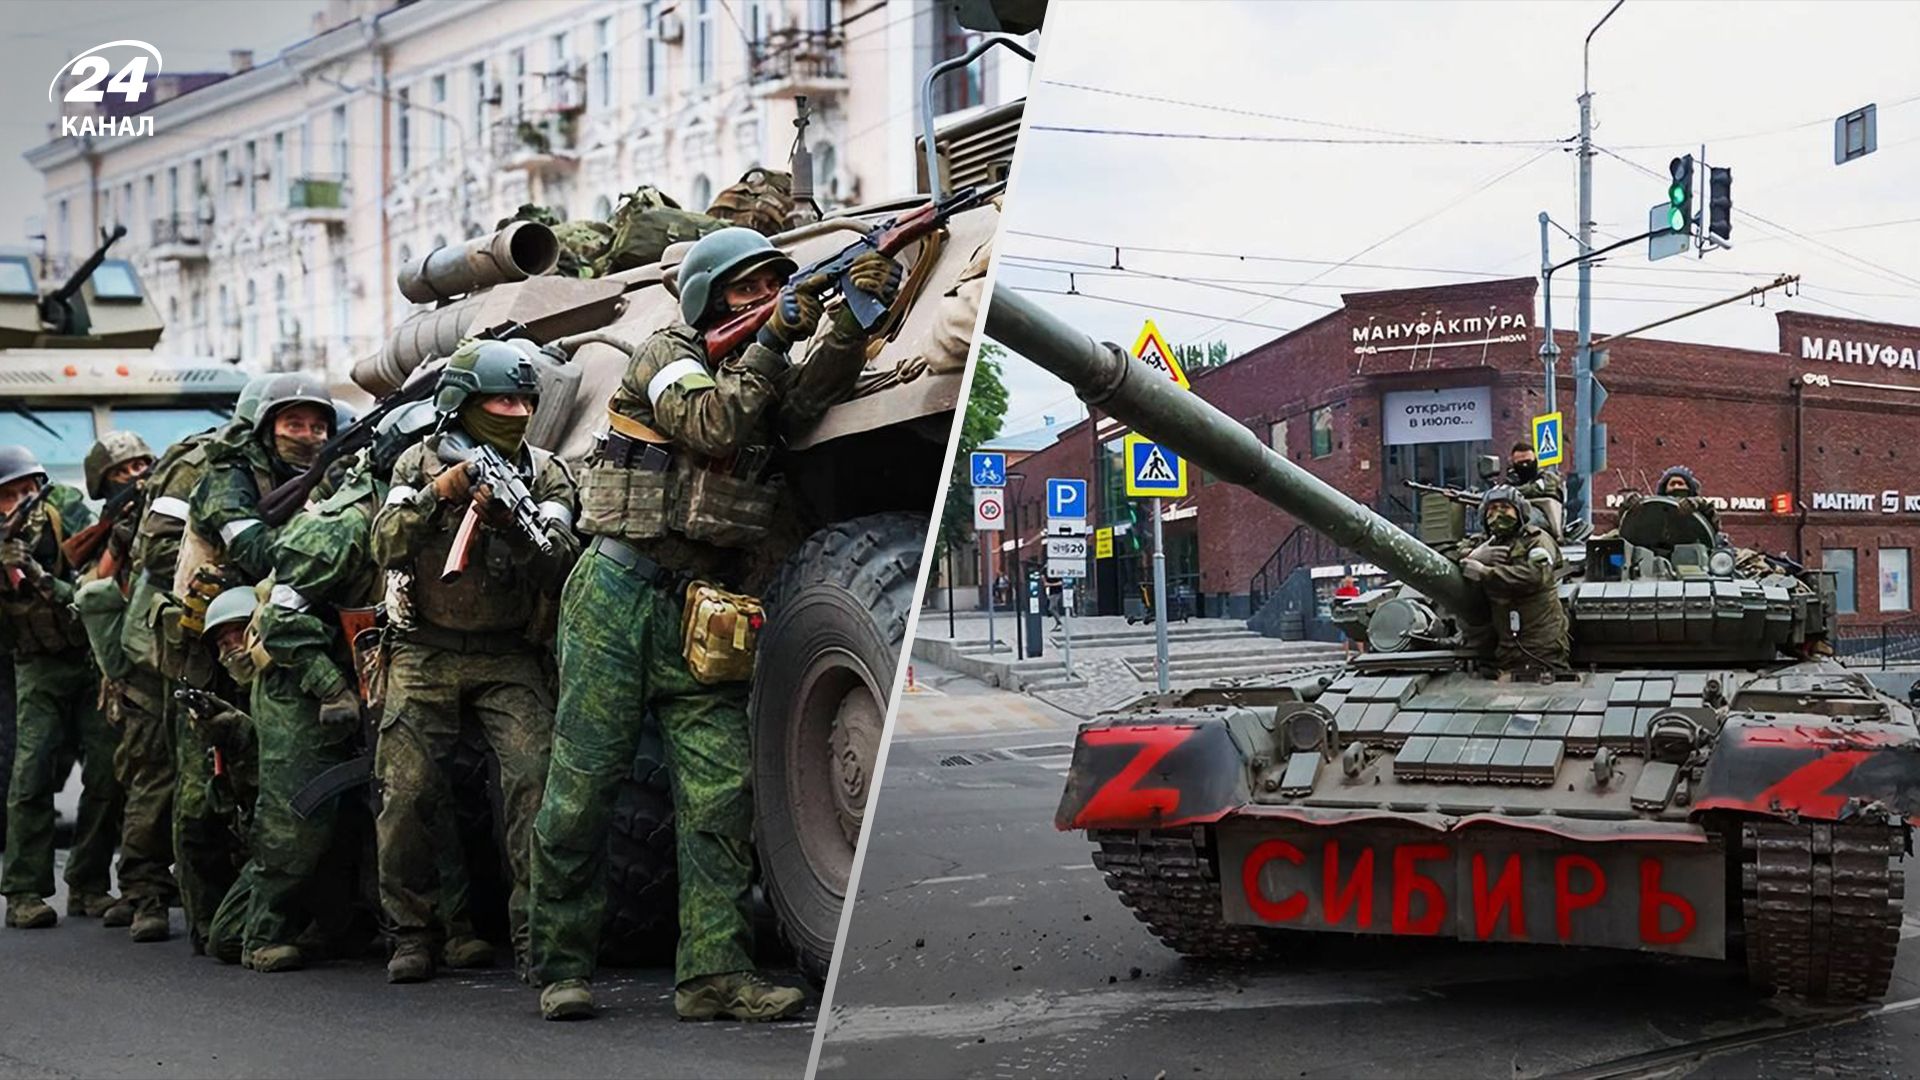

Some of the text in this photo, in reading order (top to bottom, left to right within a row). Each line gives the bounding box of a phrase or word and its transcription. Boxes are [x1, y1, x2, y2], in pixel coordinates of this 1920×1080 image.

[1352, 314, 1526, 342] МАНУФАКТУРА
[1801, 336, 1920, 371] МАНУФА
[1405, 401, 1476, 415] открытие
[1409, 416, 1473, 428] в июле...
[1056, 485, 1078, 513] P
[1730, 497, 1766, 510] РАКИ
[1812, 492, 1876, 511] МАГНИТ
[1073, 726, 1195, 828] Z
[1241, 837, 1698, 946] СИБИРЬ
